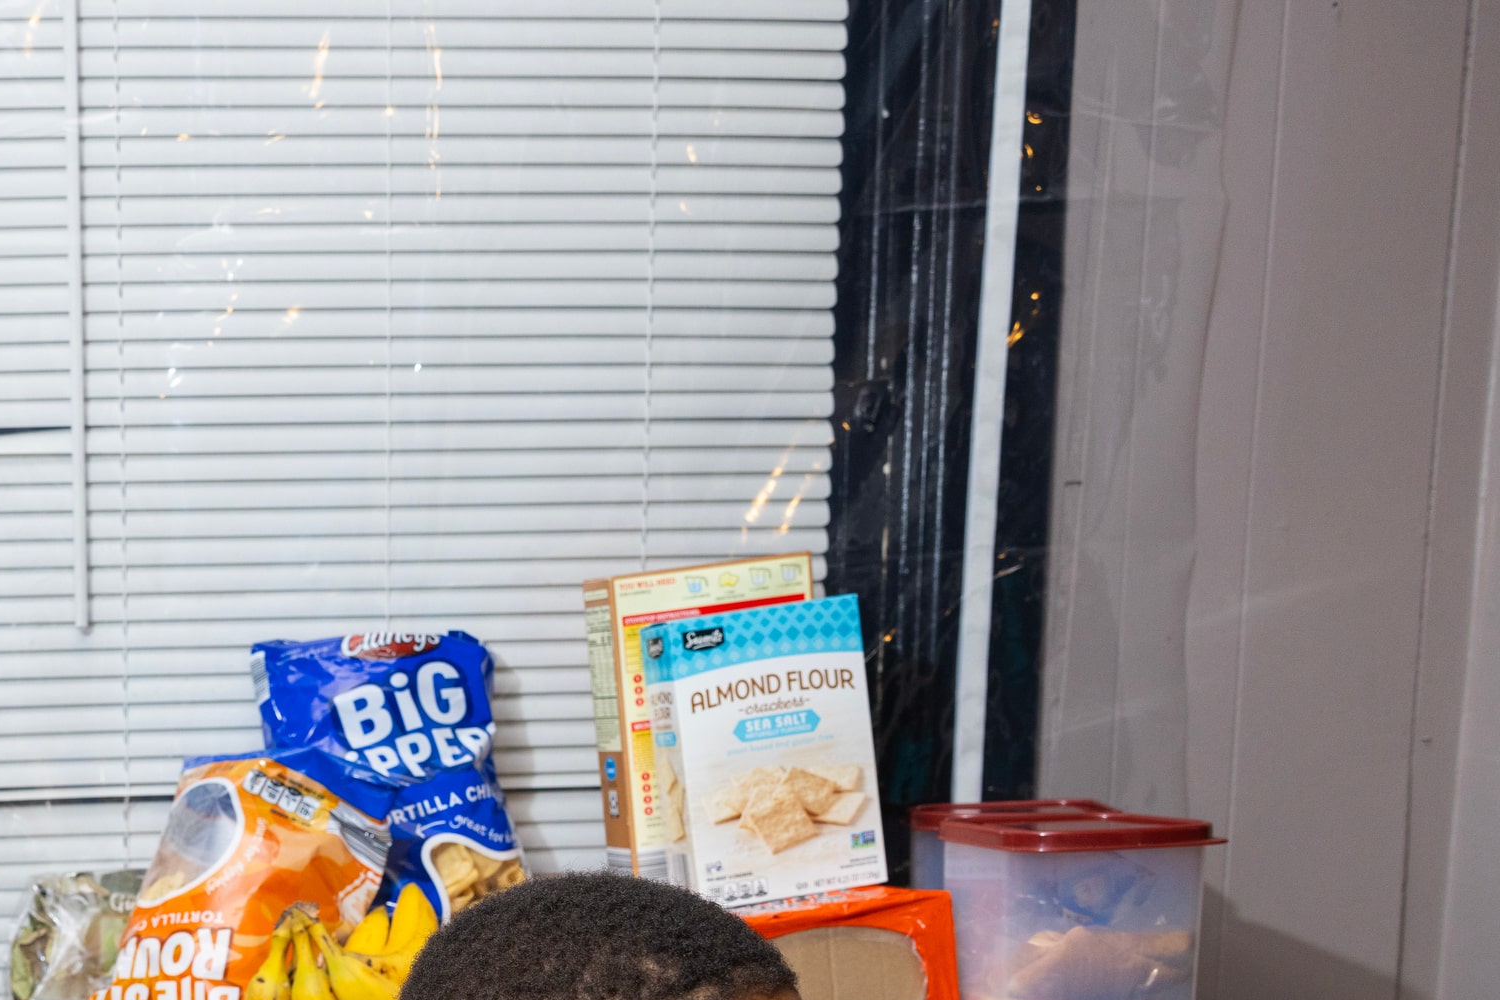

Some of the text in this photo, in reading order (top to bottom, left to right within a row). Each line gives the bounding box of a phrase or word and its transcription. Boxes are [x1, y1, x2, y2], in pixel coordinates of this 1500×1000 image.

[690, 673, 781, 715] ALMOND
[786, 668, 856, 692] FLOUR
[745, 712, 808, 732] SEA SALT
[448, 815, 486, 838] great
[150, 910, 224, 928] TORTILLA
